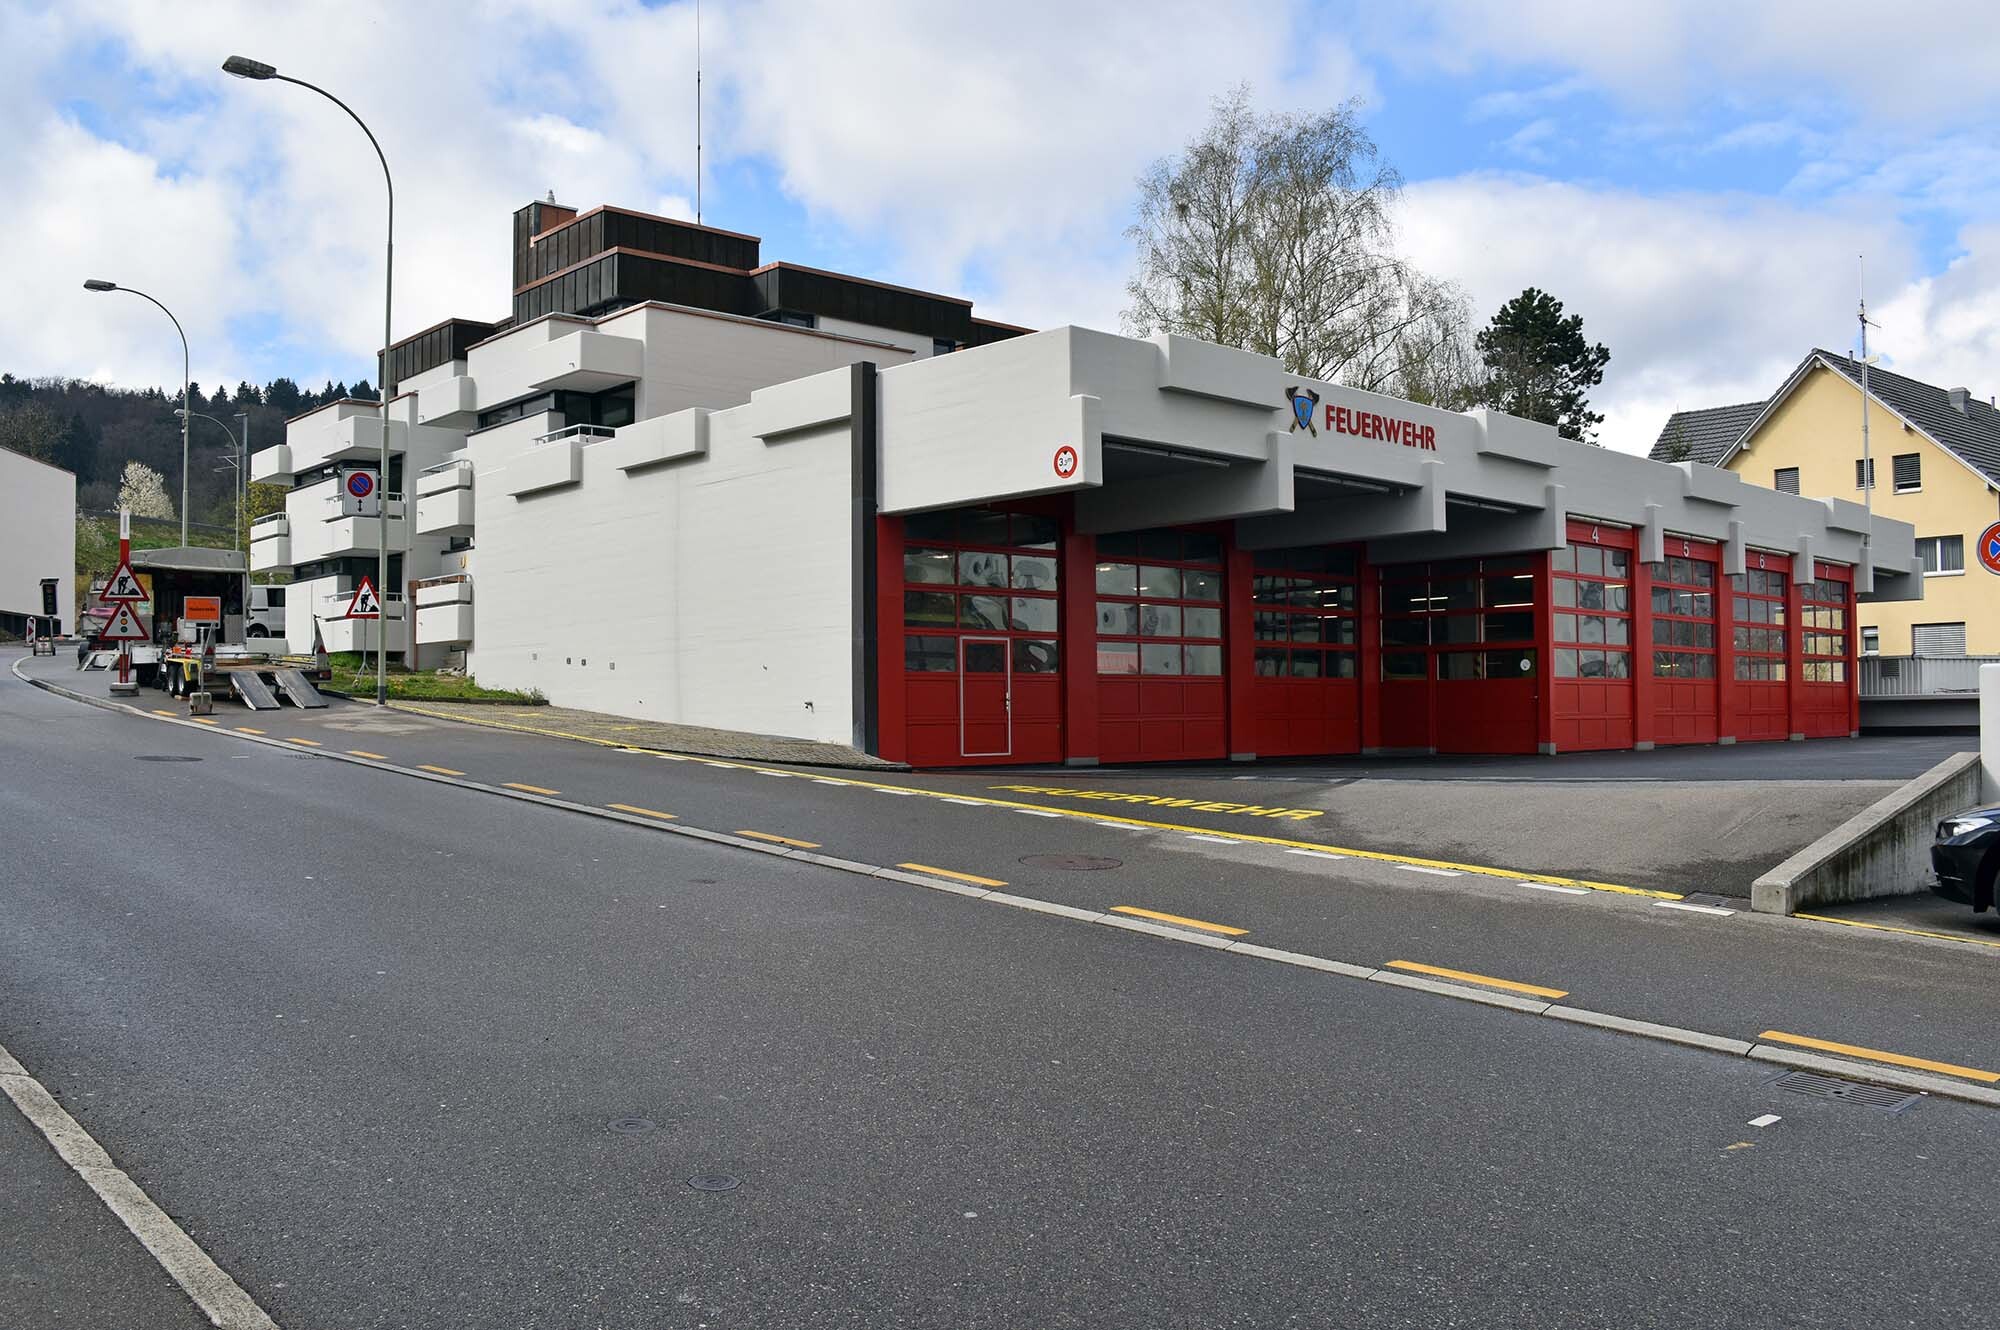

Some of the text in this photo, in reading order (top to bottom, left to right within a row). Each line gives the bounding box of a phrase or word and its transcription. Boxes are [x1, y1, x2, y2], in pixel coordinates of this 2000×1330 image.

[1326, 404, 1437, 451] FEUERWEHR
[1592, 526, 1599, 543] 4
[1683, 541, 1690, 557] 5
[1759, 554, 1765, 569] 6
[1824, 566, 1830, 579] 7
[986, 784, 1326, 821] FEUERWEHR
